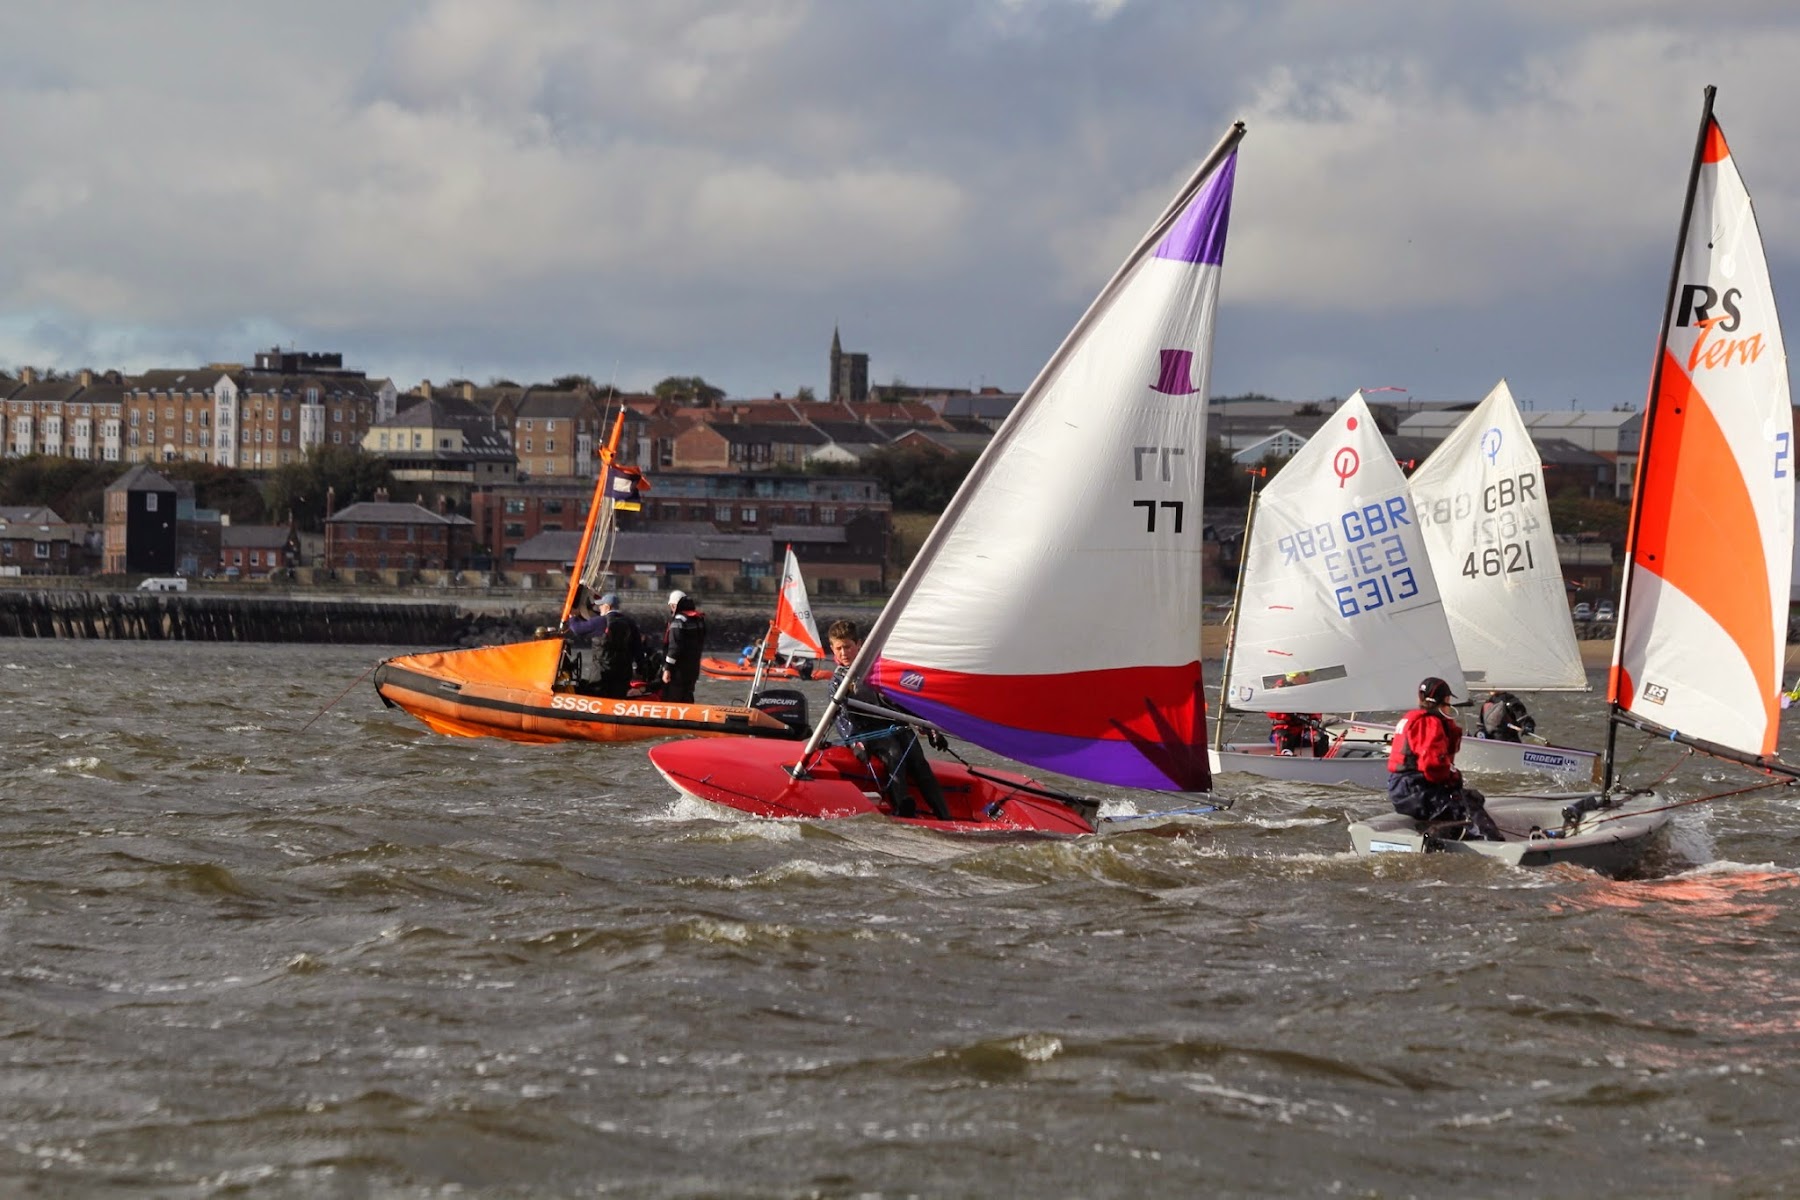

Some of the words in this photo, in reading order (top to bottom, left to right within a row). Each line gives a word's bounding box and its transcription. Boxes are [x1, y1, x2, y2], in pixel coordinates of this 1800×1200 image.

[1676, 284, 1742, 332] RS
[1687, 315, 1766, 372] Tera
[1484, 472, 1538, 513] GBR
[1133, 500, 1184, 534] 77
[1341, 496, 1412, 543] GBR
[1462, 540, 1534, 579] 4621
[1335, 567, 1419, 618] 6313
[550, 695, 602, 714] SSSC
[613, 702, 690, 720] SAFETY
[701, 709, 710, 722] 1
[756, 698, 798, 706] MERCURY
[1525, 752, 1563, 764] TRIDENT
